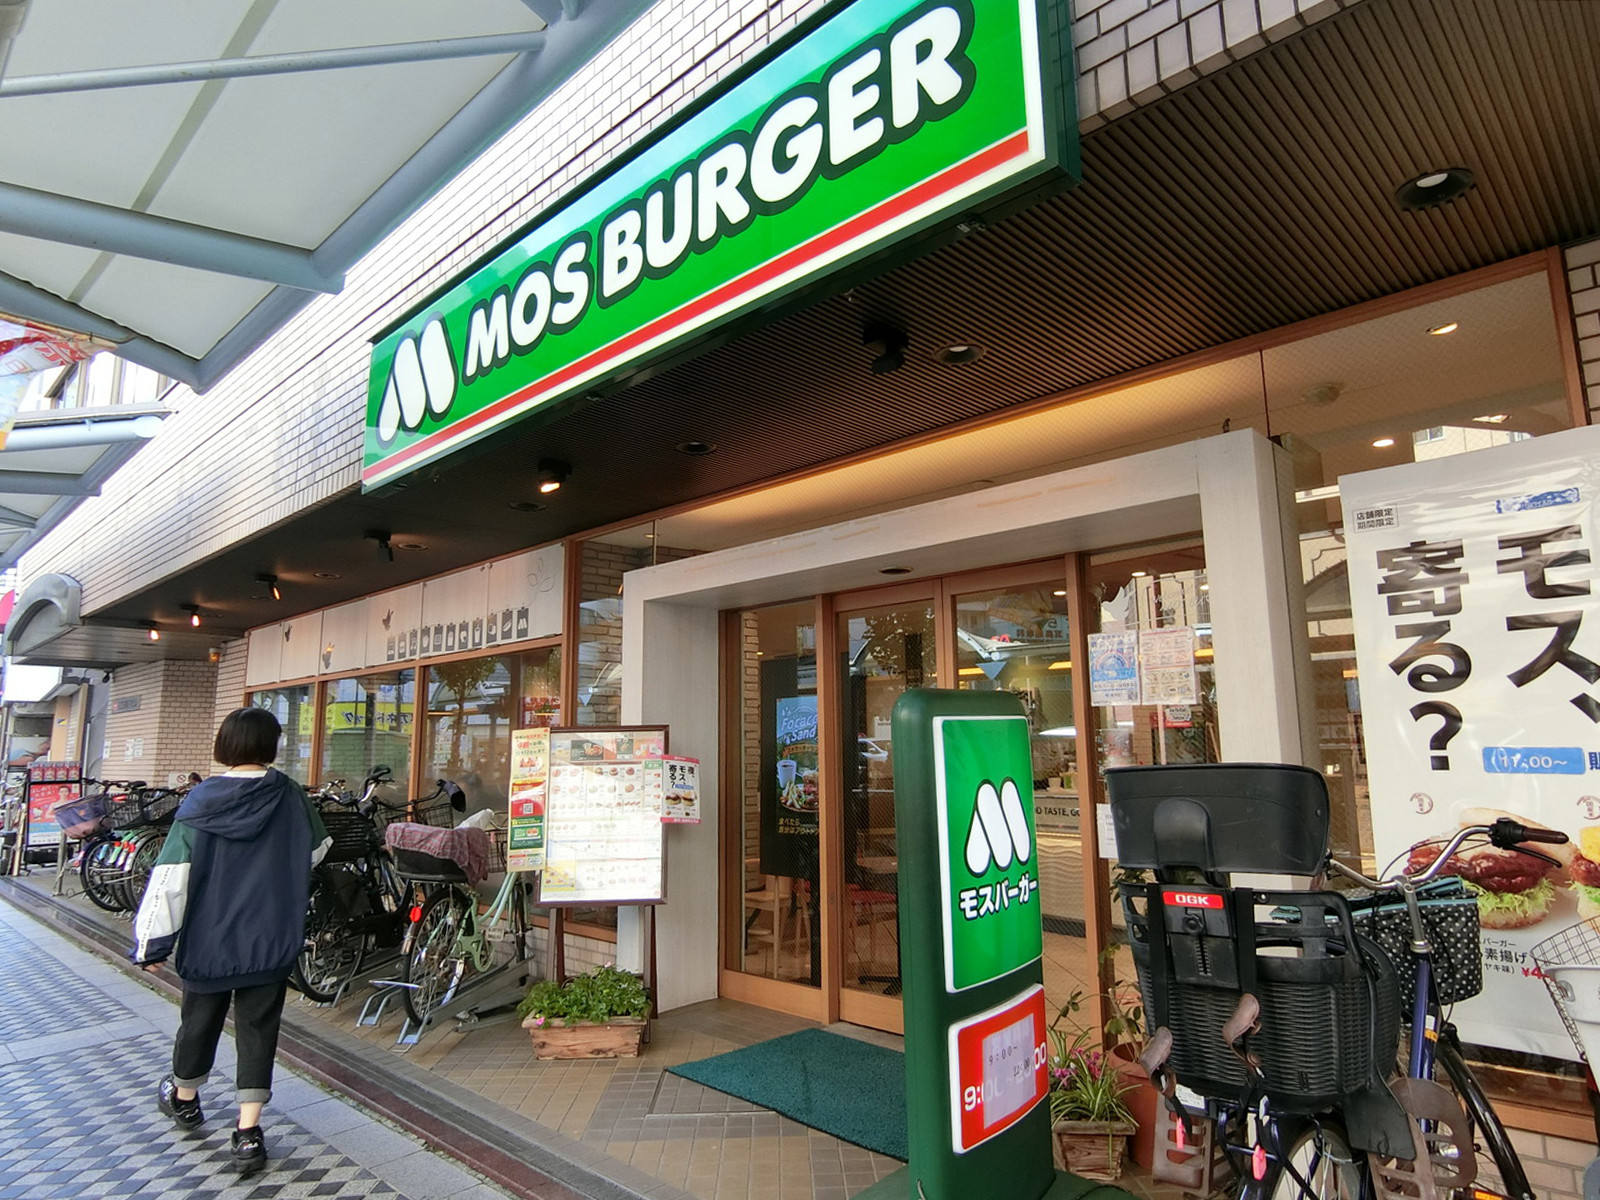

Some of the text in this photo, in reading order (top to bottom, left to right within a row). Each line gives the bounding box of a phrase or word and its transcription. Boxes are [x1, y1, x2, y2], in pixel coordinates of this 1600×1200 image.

[465, 240, 590, 378] MOS
[600, 5, 964, 300] BURGER
[1356, 507, 1394, 521] 店舗限定
[1357, 518, 1395, 531] 期間限定
[1376, 539, 1473, 771] 寄る?
[791, 725, 817, 742] Sand
[1043, 806, 1069, 817] TASTE,
[959, 873, 1038, 920] モスバーガー
[1174, 893, 1210, 906] OGK
[1484, 948, 1528, 964] 素揚げ
